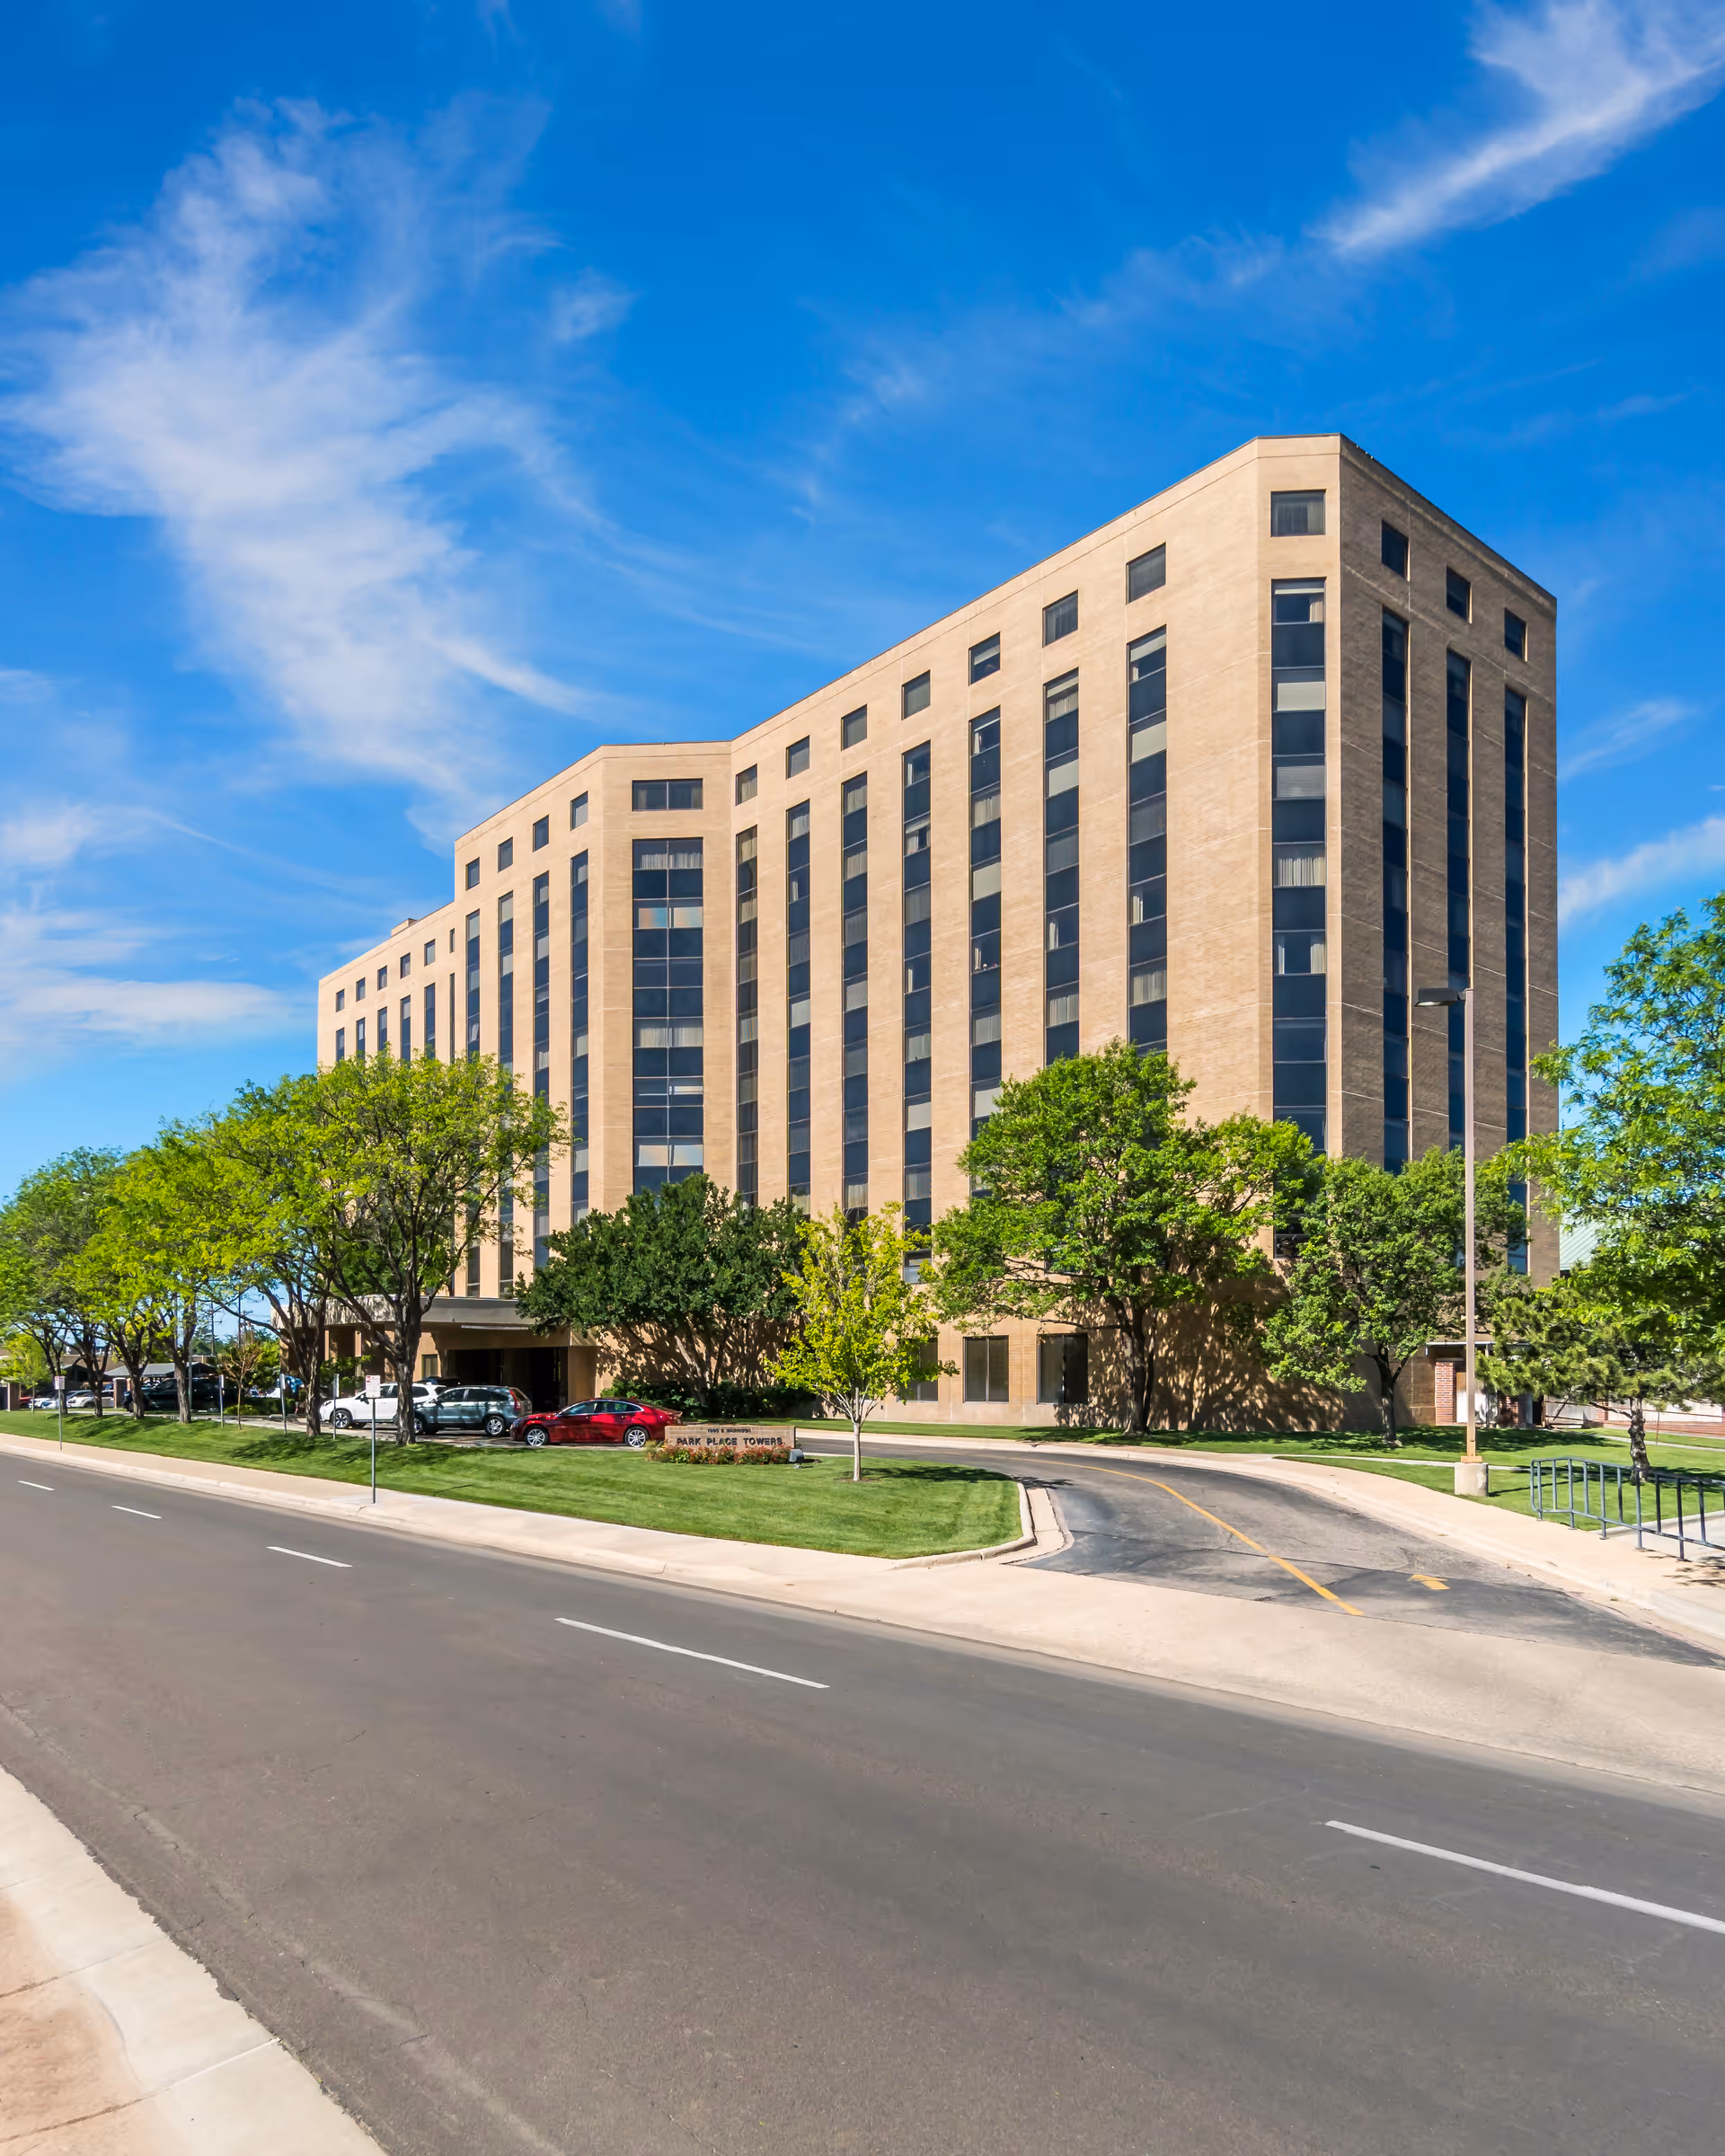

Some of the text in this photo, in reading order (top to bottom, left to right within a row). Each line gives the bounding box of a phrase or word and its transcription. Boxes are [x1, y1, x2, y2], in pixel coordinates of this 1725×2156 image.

[677, 1437, 783, 1445] PARK PLACE TOWERS
